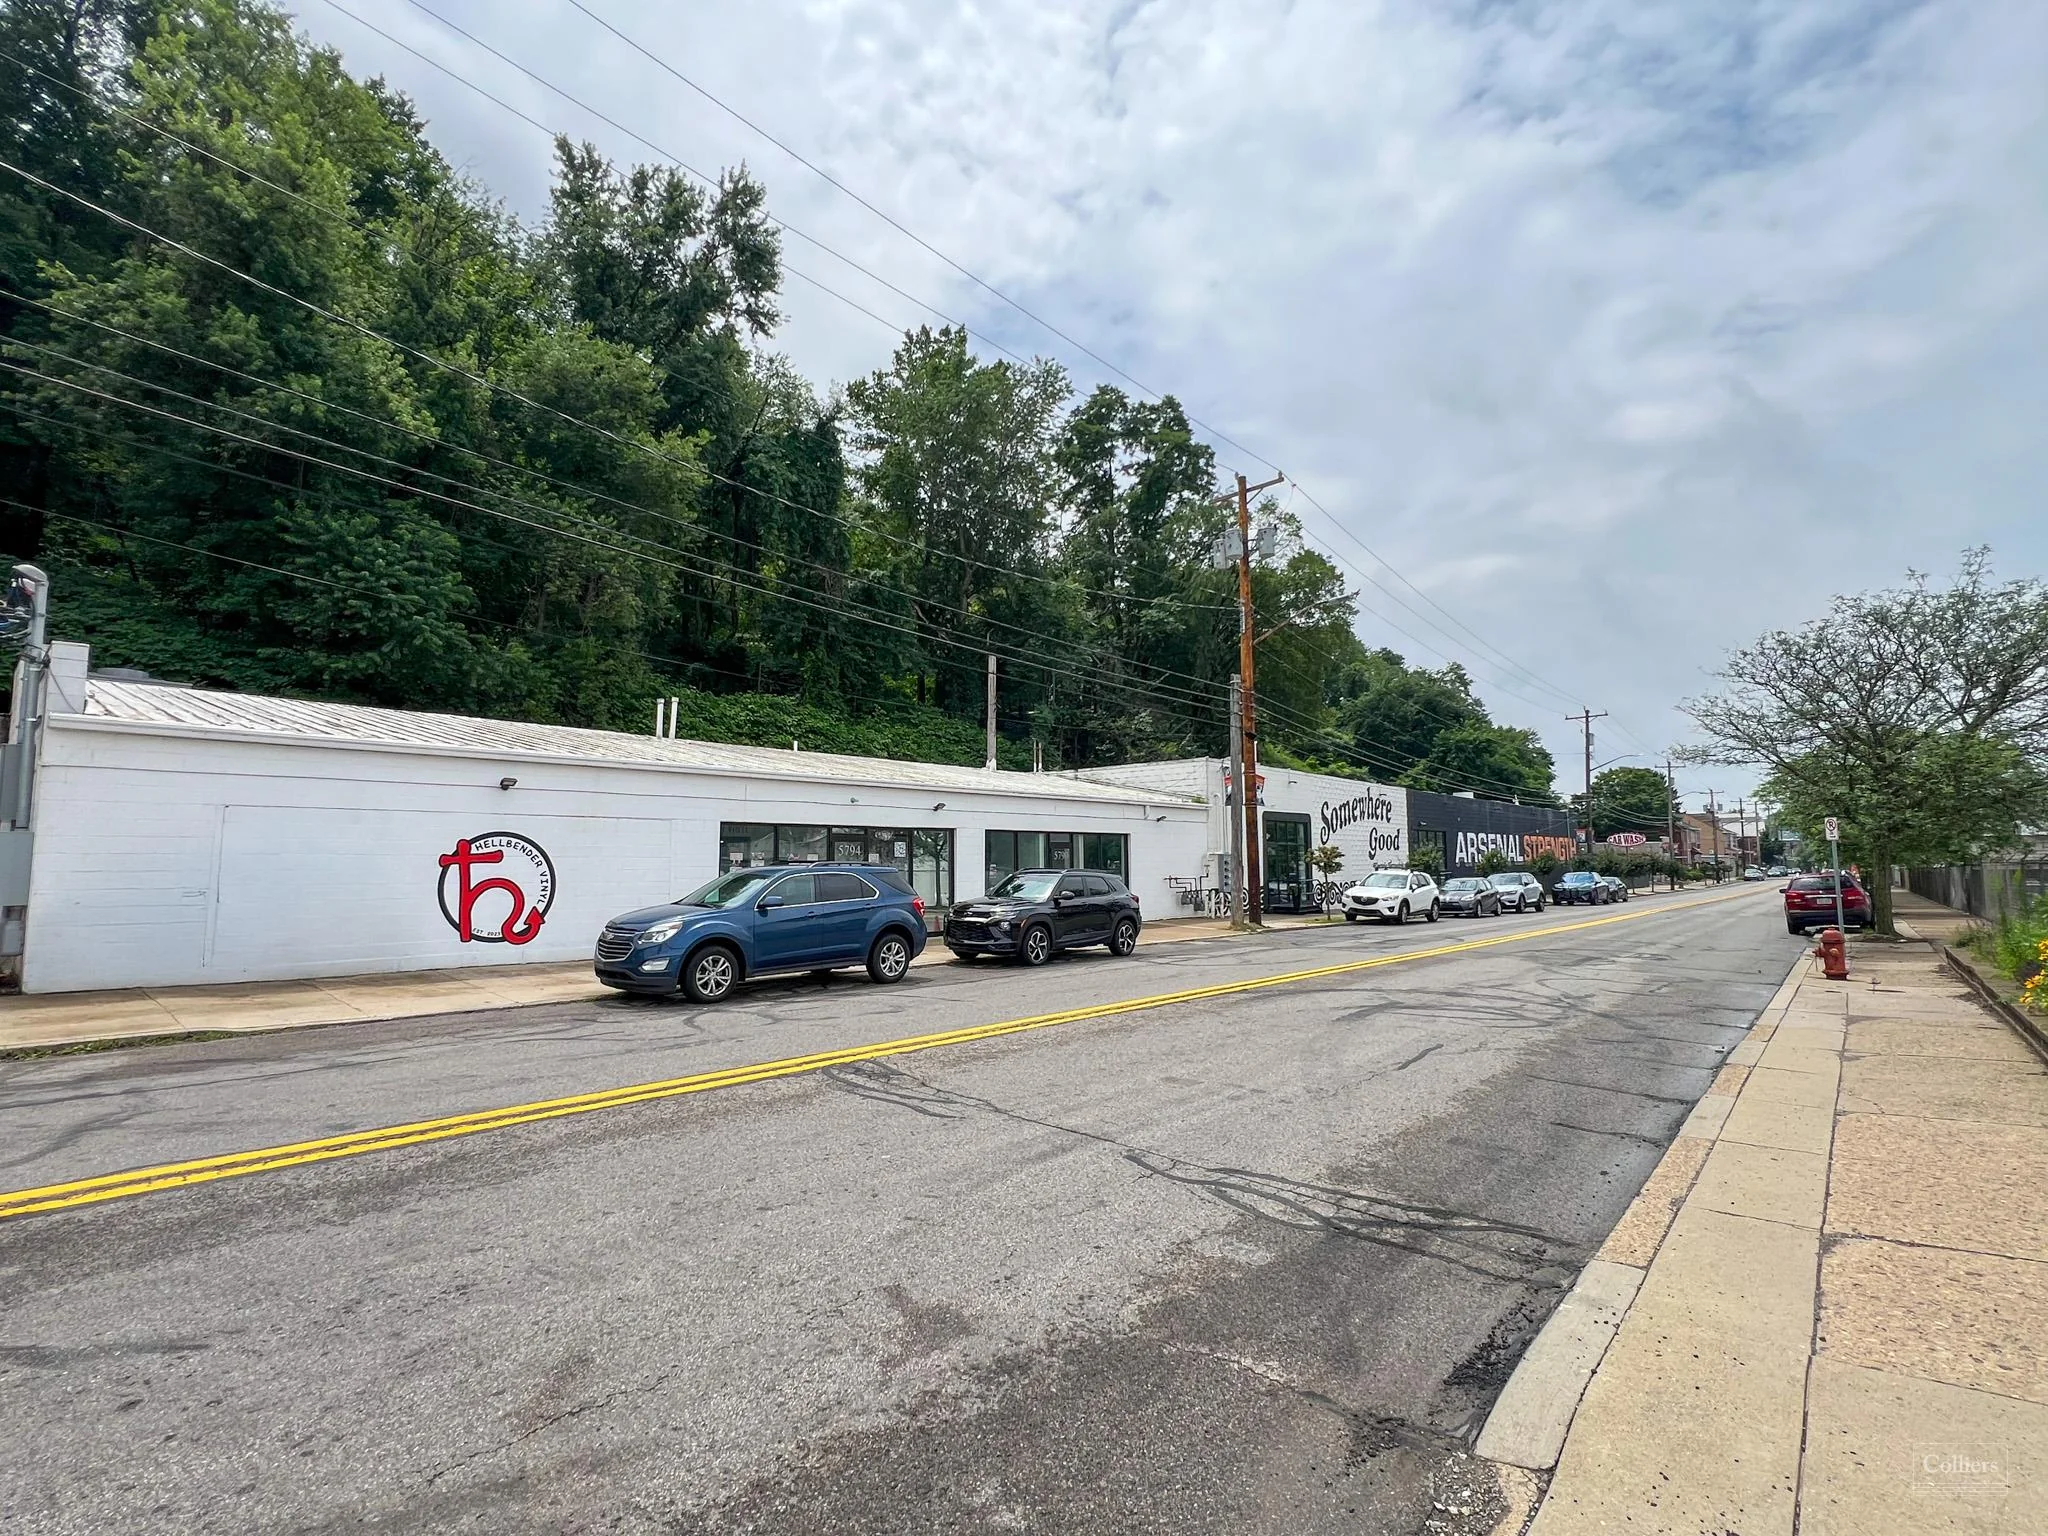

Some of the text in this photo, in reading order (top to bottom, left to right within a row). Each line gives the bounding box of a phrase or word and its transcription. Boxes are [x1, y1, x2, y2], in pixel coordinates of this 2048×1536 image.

[1320, 787, 1392, 845] Somewhere
[838, 844, 862, 857] 5794
[1368, 827, 1400, 860] Good
[1455, 831, 1577, 863] ARSENAL STRENGTH
[1609, 835, 1644, 844] CAR WASH
[474, 839, 549, 905] HELLBENDER VINYL
